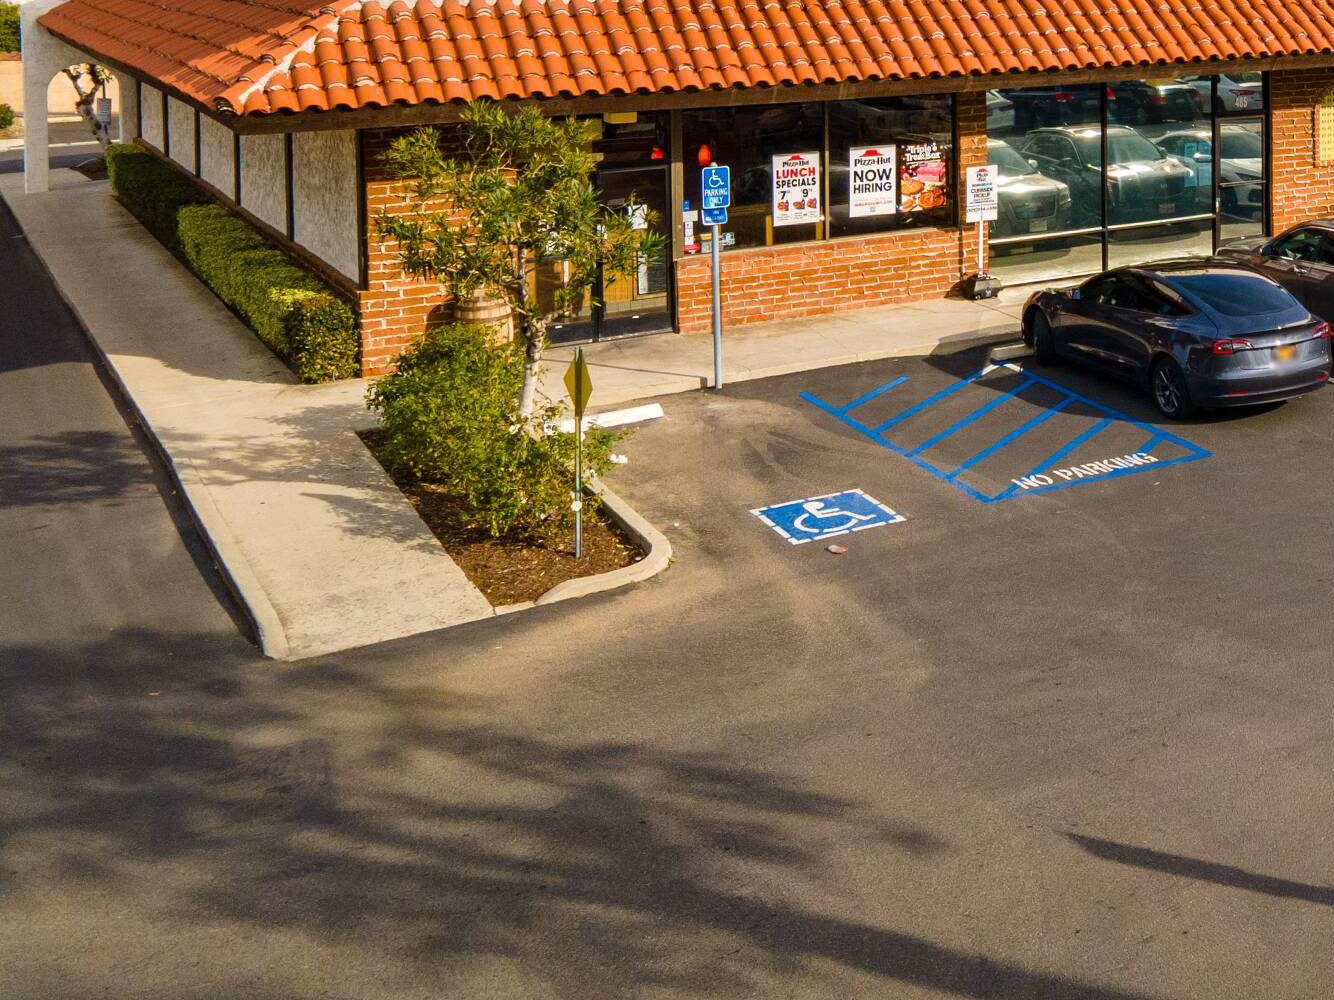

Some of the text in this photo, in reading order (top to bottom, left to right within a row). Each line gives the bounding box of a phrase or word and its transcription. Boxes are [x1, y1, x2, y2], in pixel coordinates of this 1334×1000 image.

[776, 167, 816, 179] LUNCH
[854, 168, 892, 183] NOW
[776, 177, 817, 188] SPECIALS
[854, 182, 892, 194] HIRING
[705, 187, 728, 197] PARKING
[709, 196, 724, 204] ONLY
[1011, 452, 1159, 489] NO PARKING
